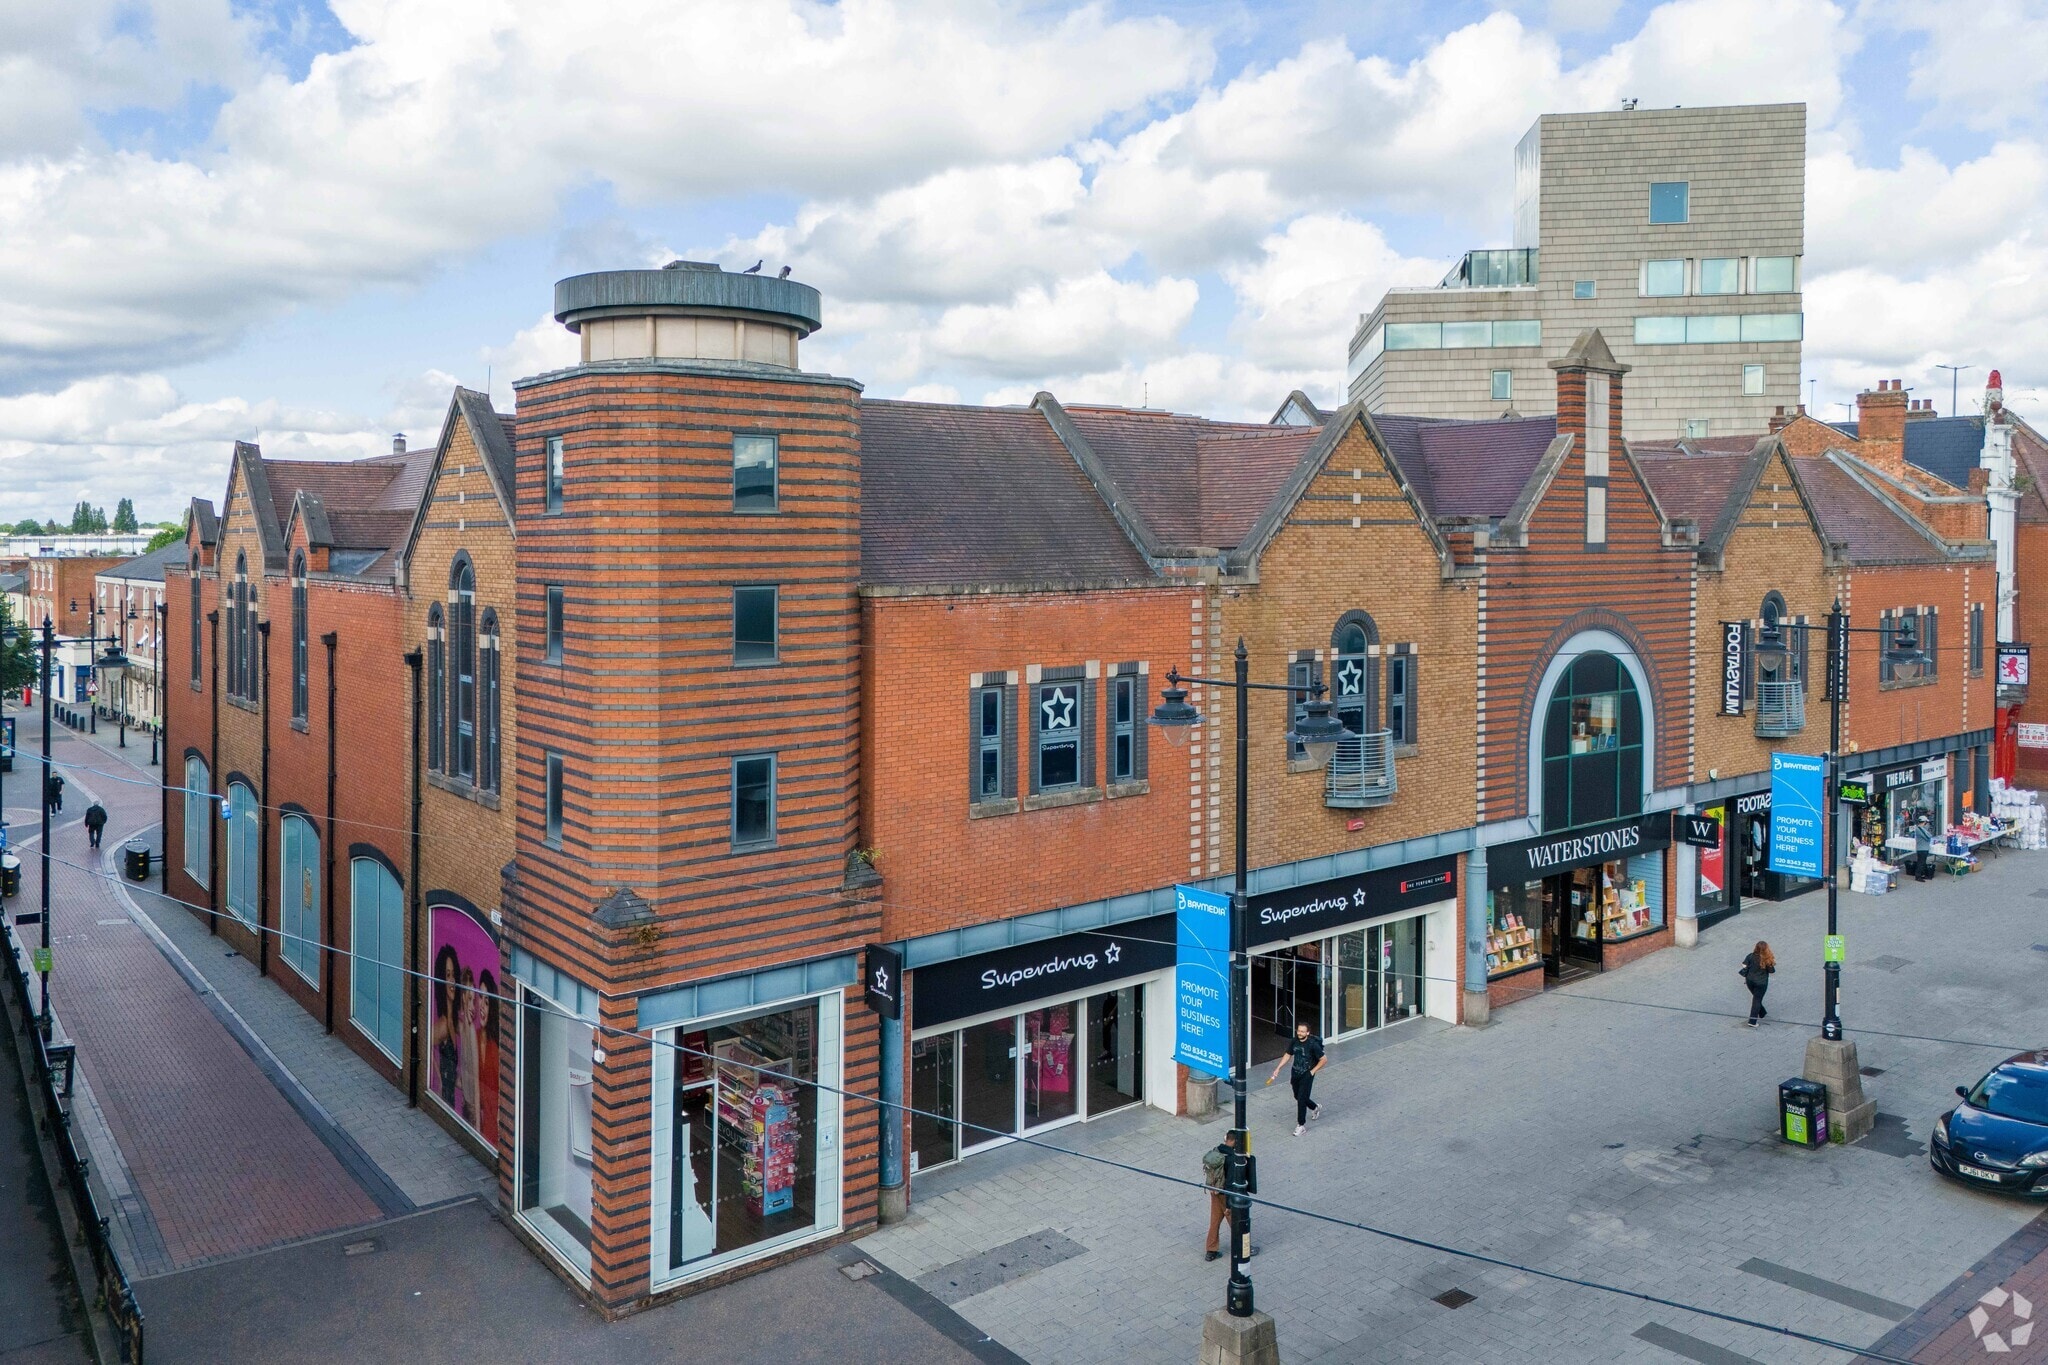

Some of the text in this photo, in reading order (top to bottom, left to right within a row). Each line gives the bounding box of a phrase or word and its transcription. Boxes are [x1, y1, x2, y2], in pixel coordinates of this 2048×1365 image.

[1783, 762, 1820, 771] BAYMEDIA
[1886, 772, 1898, 787] THE
[1737, 793, 1772, 814] FOOTAS
[1691, 821, 1712, 837] W
[1776, 816, 1813, 827] PROMOTE
[1776, 826, 1797, 834] YOUR
[1527, 825, 1639, 869] WATERSTONES
[1775, 844, 1798, 852] HERE!
[1776, 834, 1814, 846] BUSINESS
[1187, 900, 1226, 916] BAYMEDIA
[1261, 898, 1348, 924] Superdrug
[981, 954, 1098, 989] Superdrug
[1181, 979, 1219, 1000] PROMOTE
[1181, 994, 1203, 1008] YOUR
[1181, 1007, 1221, 1029] BUSINESS
[1181, 1021, 1204, 1037] HERE!
[1181, 1042, 1223, 1063] 020 8343 2525
